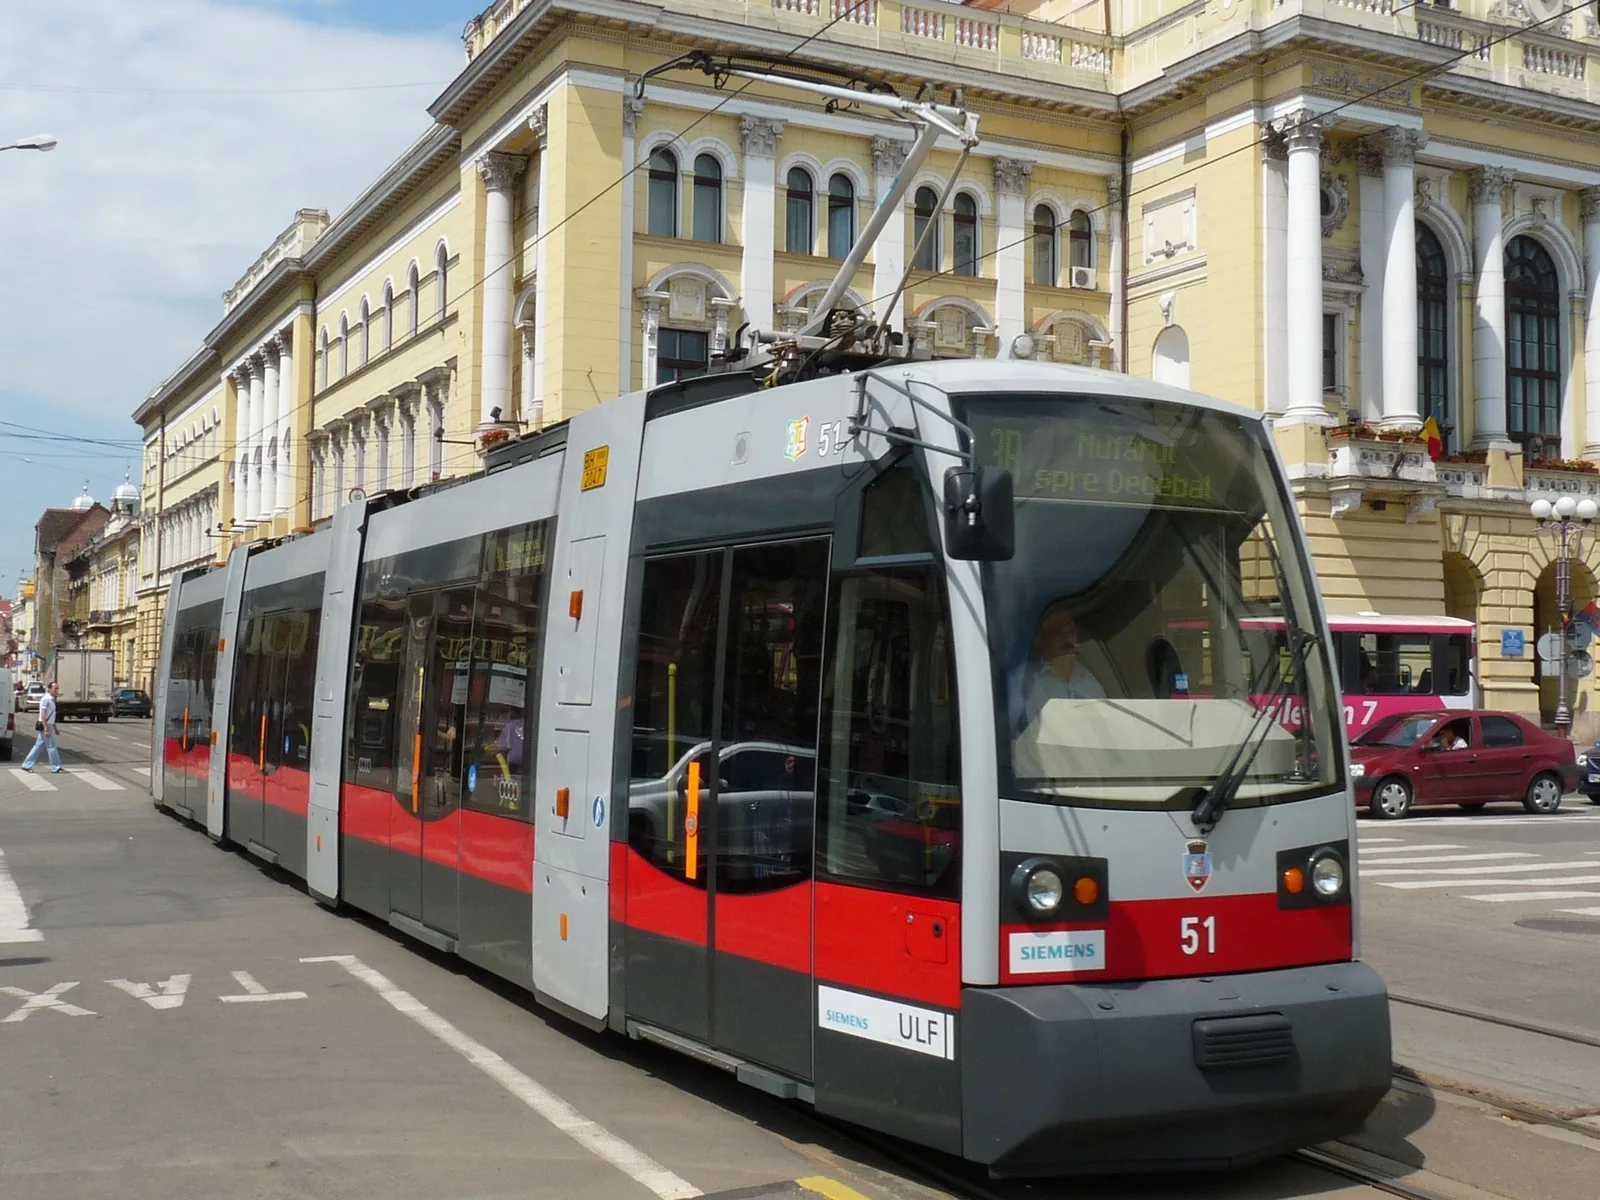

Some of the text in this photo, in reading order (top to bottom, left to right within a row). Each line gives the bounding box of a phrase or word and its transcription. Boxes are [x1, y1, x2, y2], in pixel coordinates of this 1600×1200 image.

[817, 420, 842, 457] 51
[584, 452, 595, 470] BH
[1034, 468, 1212, 499] spre Decebal
[1360, 700, 1378, 725] 7
[1180, 916, 1216, 955] 51
[1020, 943, 1095, 961] SIEMENS
[826, 1009, 938, 1045] SIEMENS ULF
